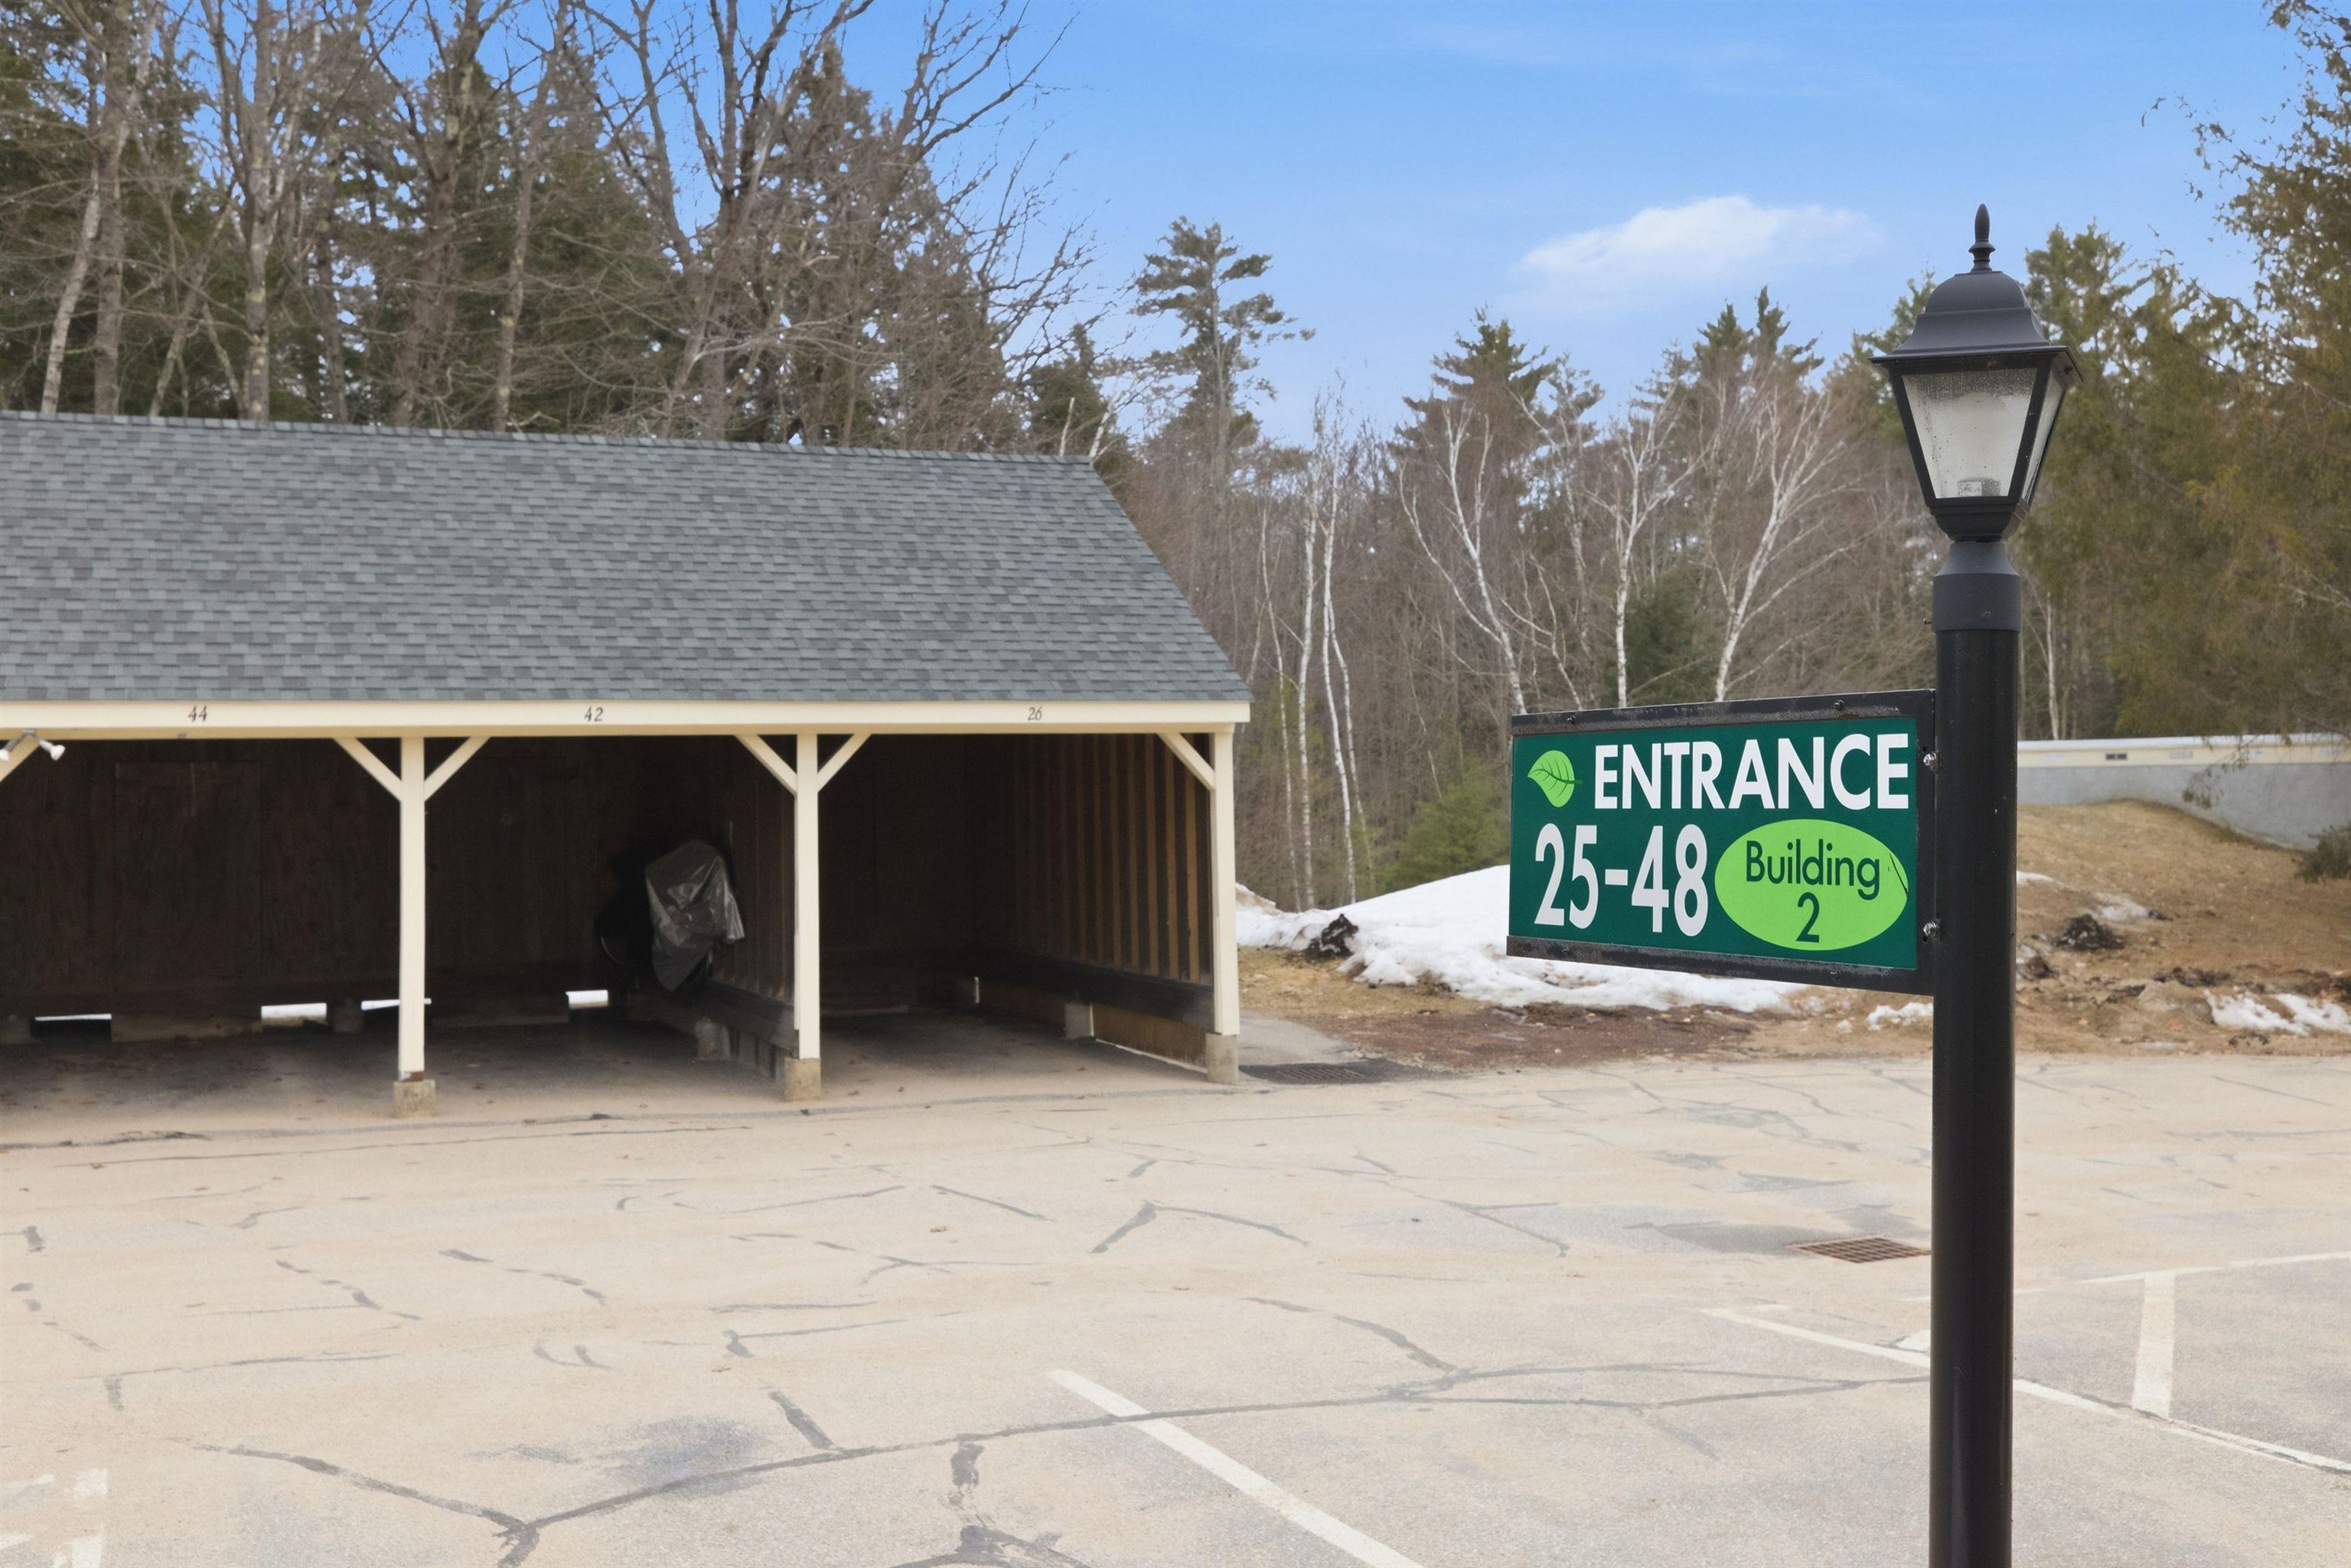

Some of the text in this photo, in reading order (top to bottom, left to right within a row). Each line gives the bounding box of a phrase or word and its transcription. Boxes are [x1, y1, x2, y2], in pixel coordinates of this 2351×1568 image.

[187, 706, 207, 722] 44
[584, 706, 603, 722] 42
[1594, 733, 1909, 810] ENTRANCE
[1534, 823, 1708, 937] 25-48
[1746, 839, 1880, 901] Building
[1795, 892, 1821, 943] 2
